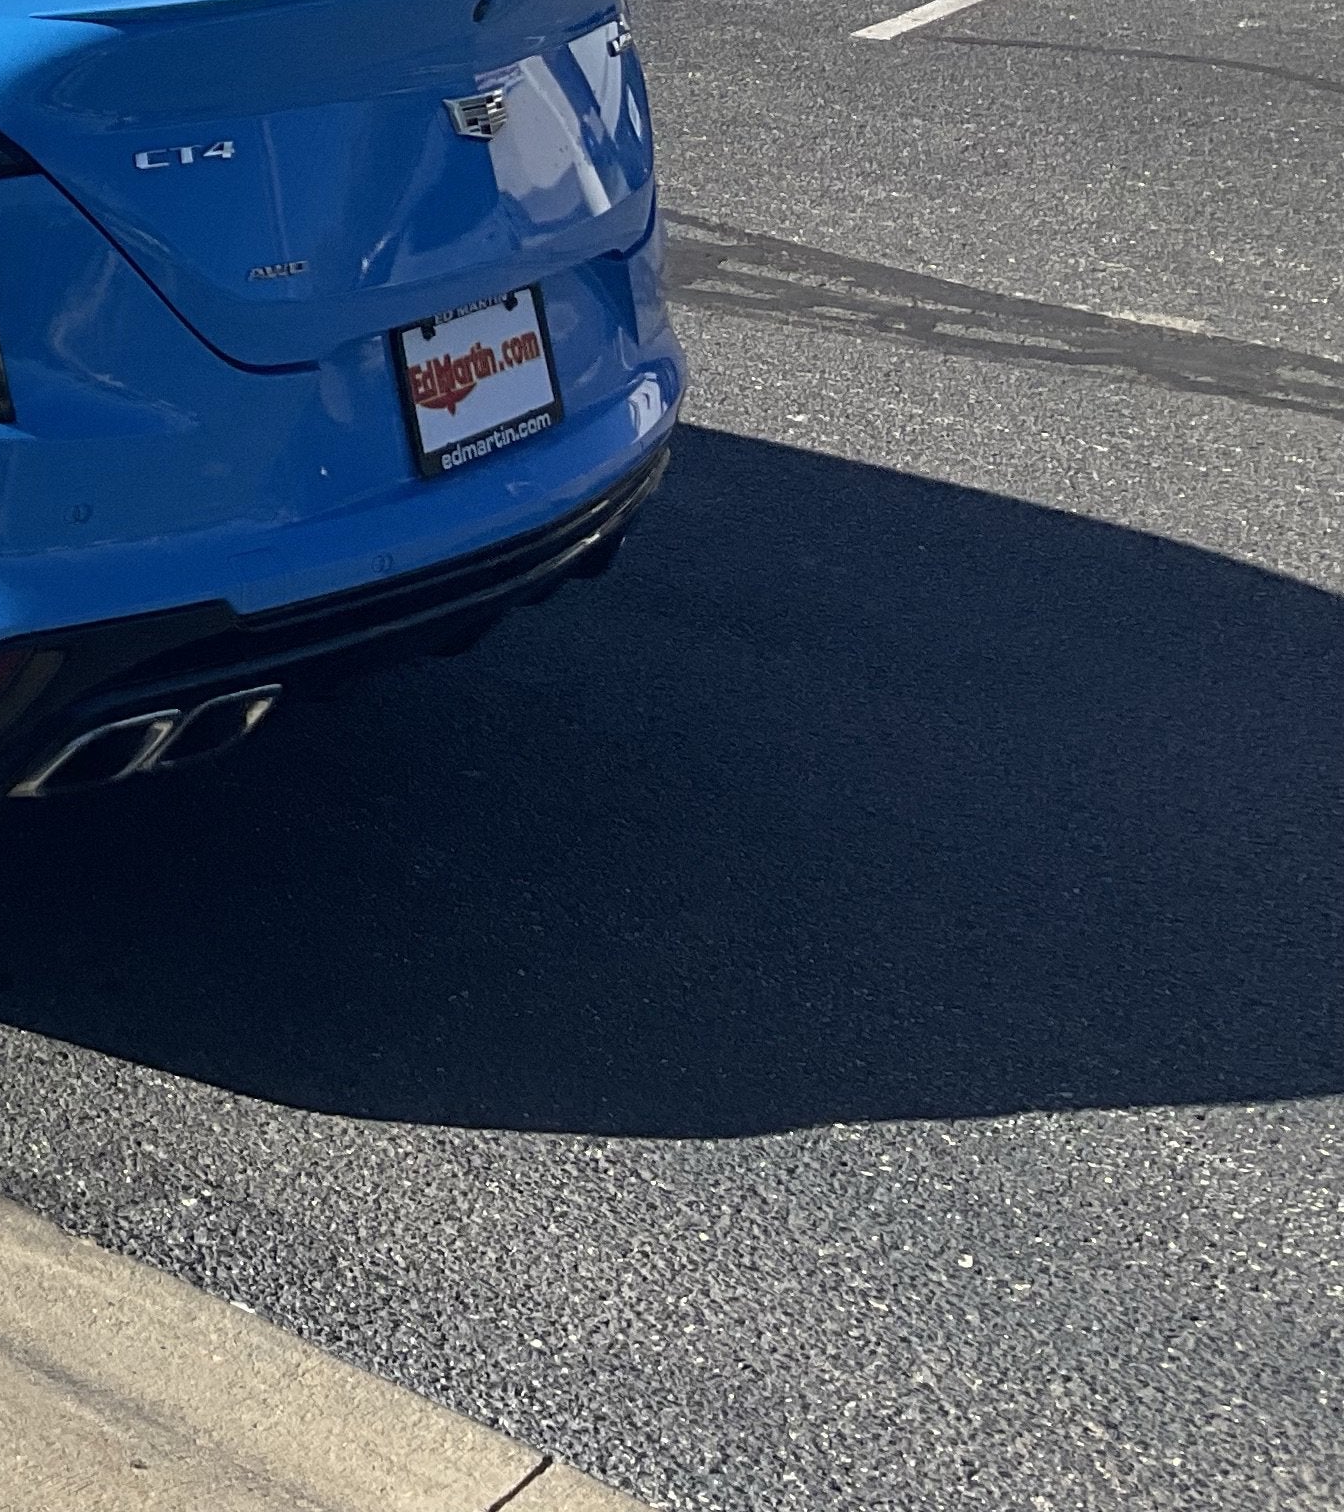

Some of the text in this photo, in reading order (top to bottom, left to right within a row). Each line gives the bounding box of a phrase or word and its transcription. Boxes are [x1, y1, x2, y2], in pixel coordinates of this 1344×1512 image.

[134, 140, 236, 170] CT4
[248, 259, 309, 282] AWD
[434, 292, 509, 326] ED MARTIN
[408, 330, 541, 404] EdMartin.com
[441, 411, 552, 470] edmartin.com
